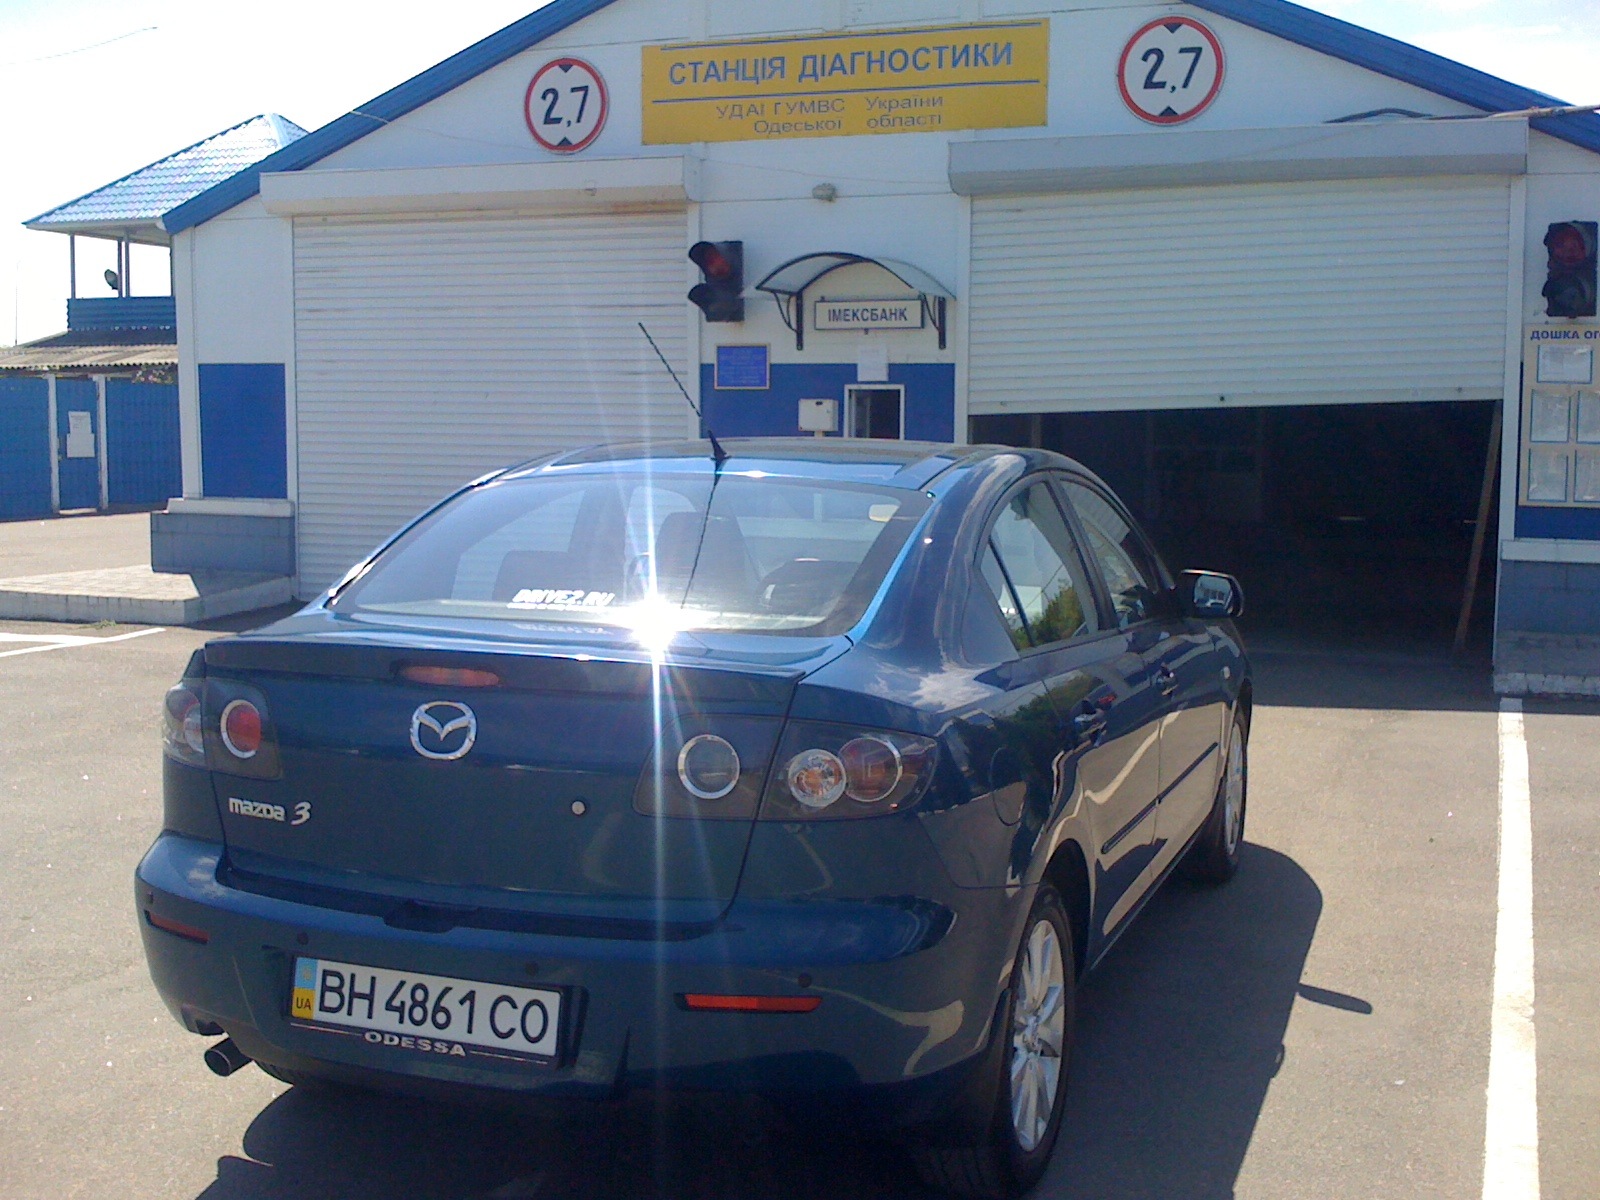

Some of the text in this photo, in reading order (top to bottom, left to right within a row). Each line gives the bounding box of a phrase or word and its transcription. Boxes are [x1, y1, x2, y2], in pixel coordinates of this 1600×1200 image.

[669, 42, 1013, 85] СТАНЦІЯ ДІАГНОСТИКИ
[1141, 46, 1203, 94] 2,7
[540, 85, 589, 128] 2,7
[866, 96, 944, 112] України
[866, 114, 942, 129] області
[827, 307, 909, 323] ІМЕКСБАНК
[1530, 330, 1600, 341] ДОШКА ОГ
[290, 801, 312, 826] 3
[295, 997, 313, 1011] UA
[385, 979, 477, 1035] 4861
[363, 1030, 467, 1057] ODESSA
